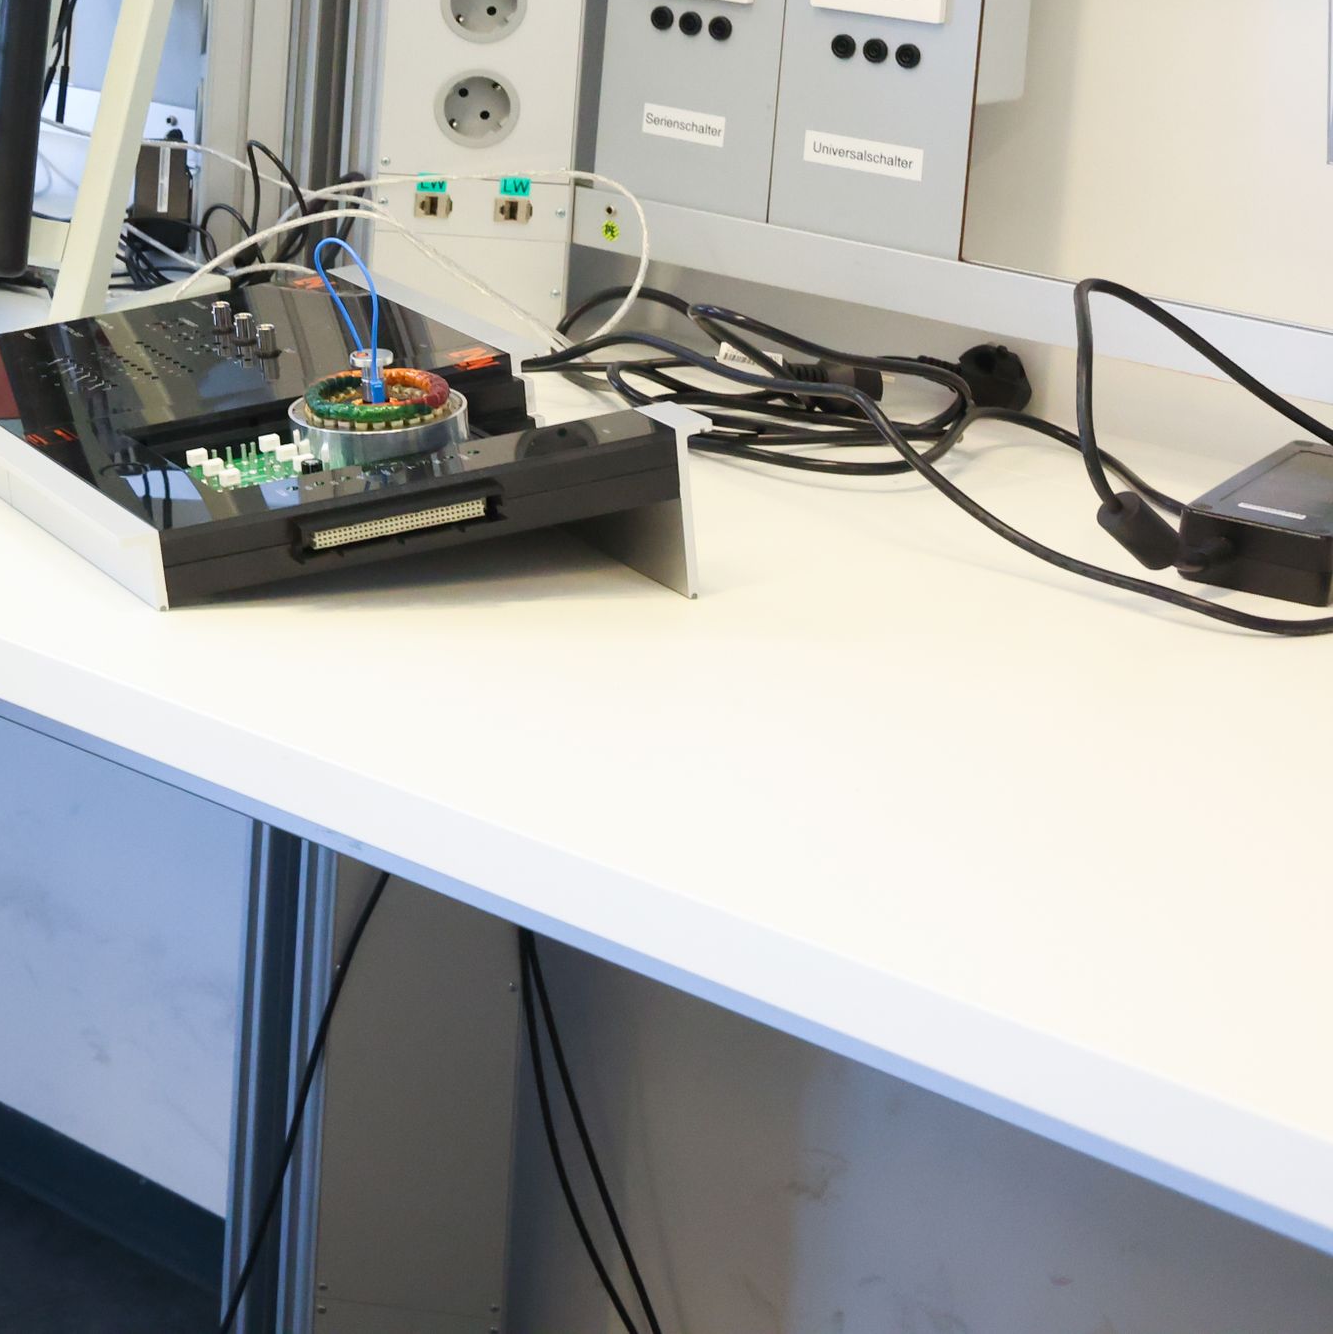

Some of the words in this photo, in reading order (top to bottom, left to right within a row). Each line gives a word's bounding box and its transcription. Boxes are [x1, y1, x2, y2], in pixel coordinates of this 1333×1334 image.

[644, 112, 722, 140] Serienschalter
[813, 141, 914, 171] Universalschalter
[502, 179, 530, 194] LW
